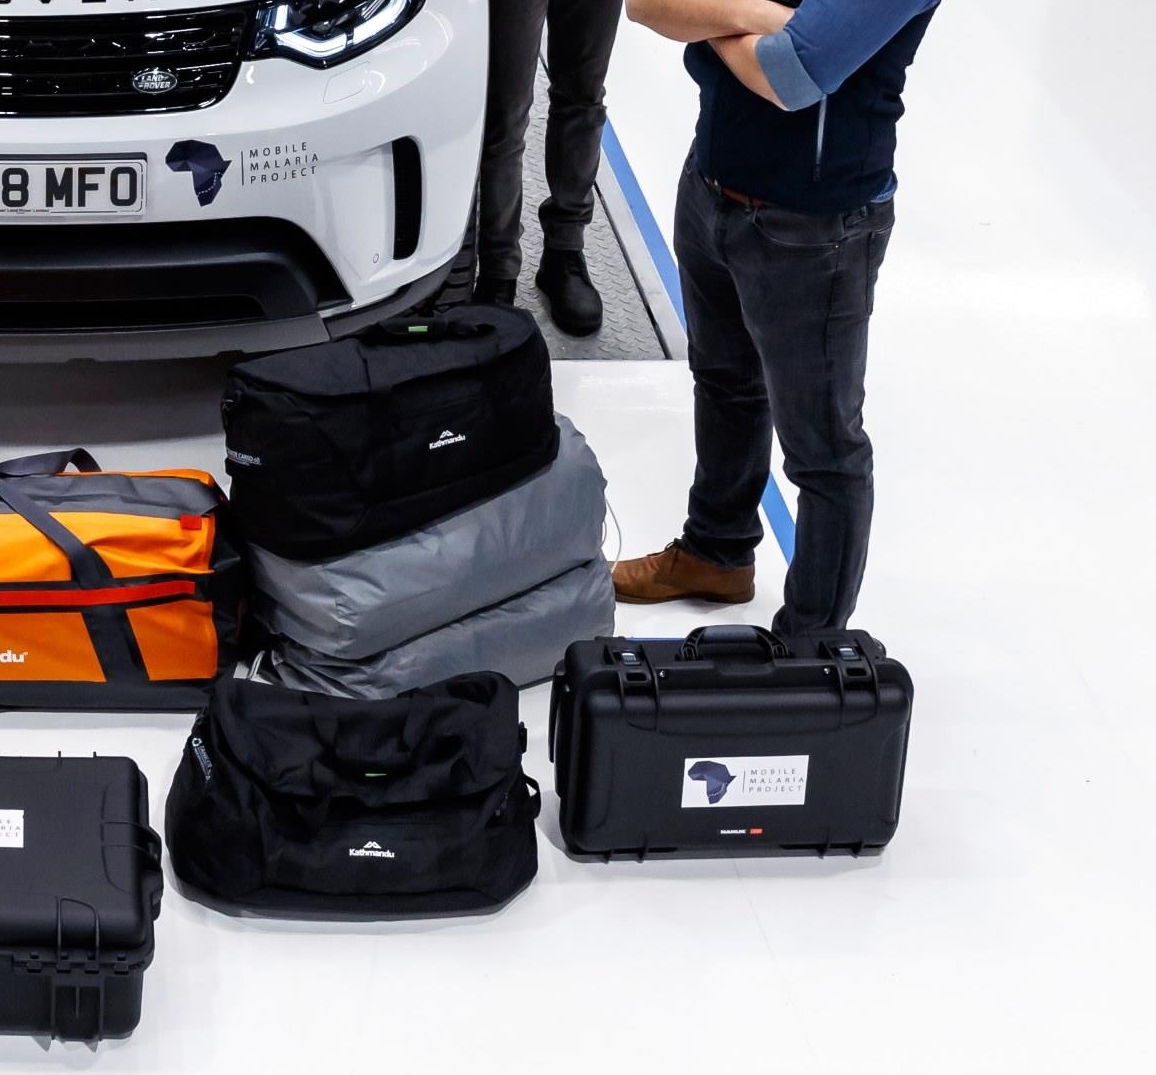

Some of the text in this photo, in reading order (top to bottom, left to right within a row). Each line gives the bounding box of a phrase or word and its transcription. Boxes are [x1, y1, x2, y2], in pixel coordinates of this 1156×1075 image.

[249, 142, 307, 158] MOBILE
[250, 153, 318, 171] MALARIA
[250, 166, 317, 184] PROJECT
[46, 166, 138, 208] MFO
[429, 434, 466, 449] Kathmandu
[349, 848, 395, 858] Kathmandu
